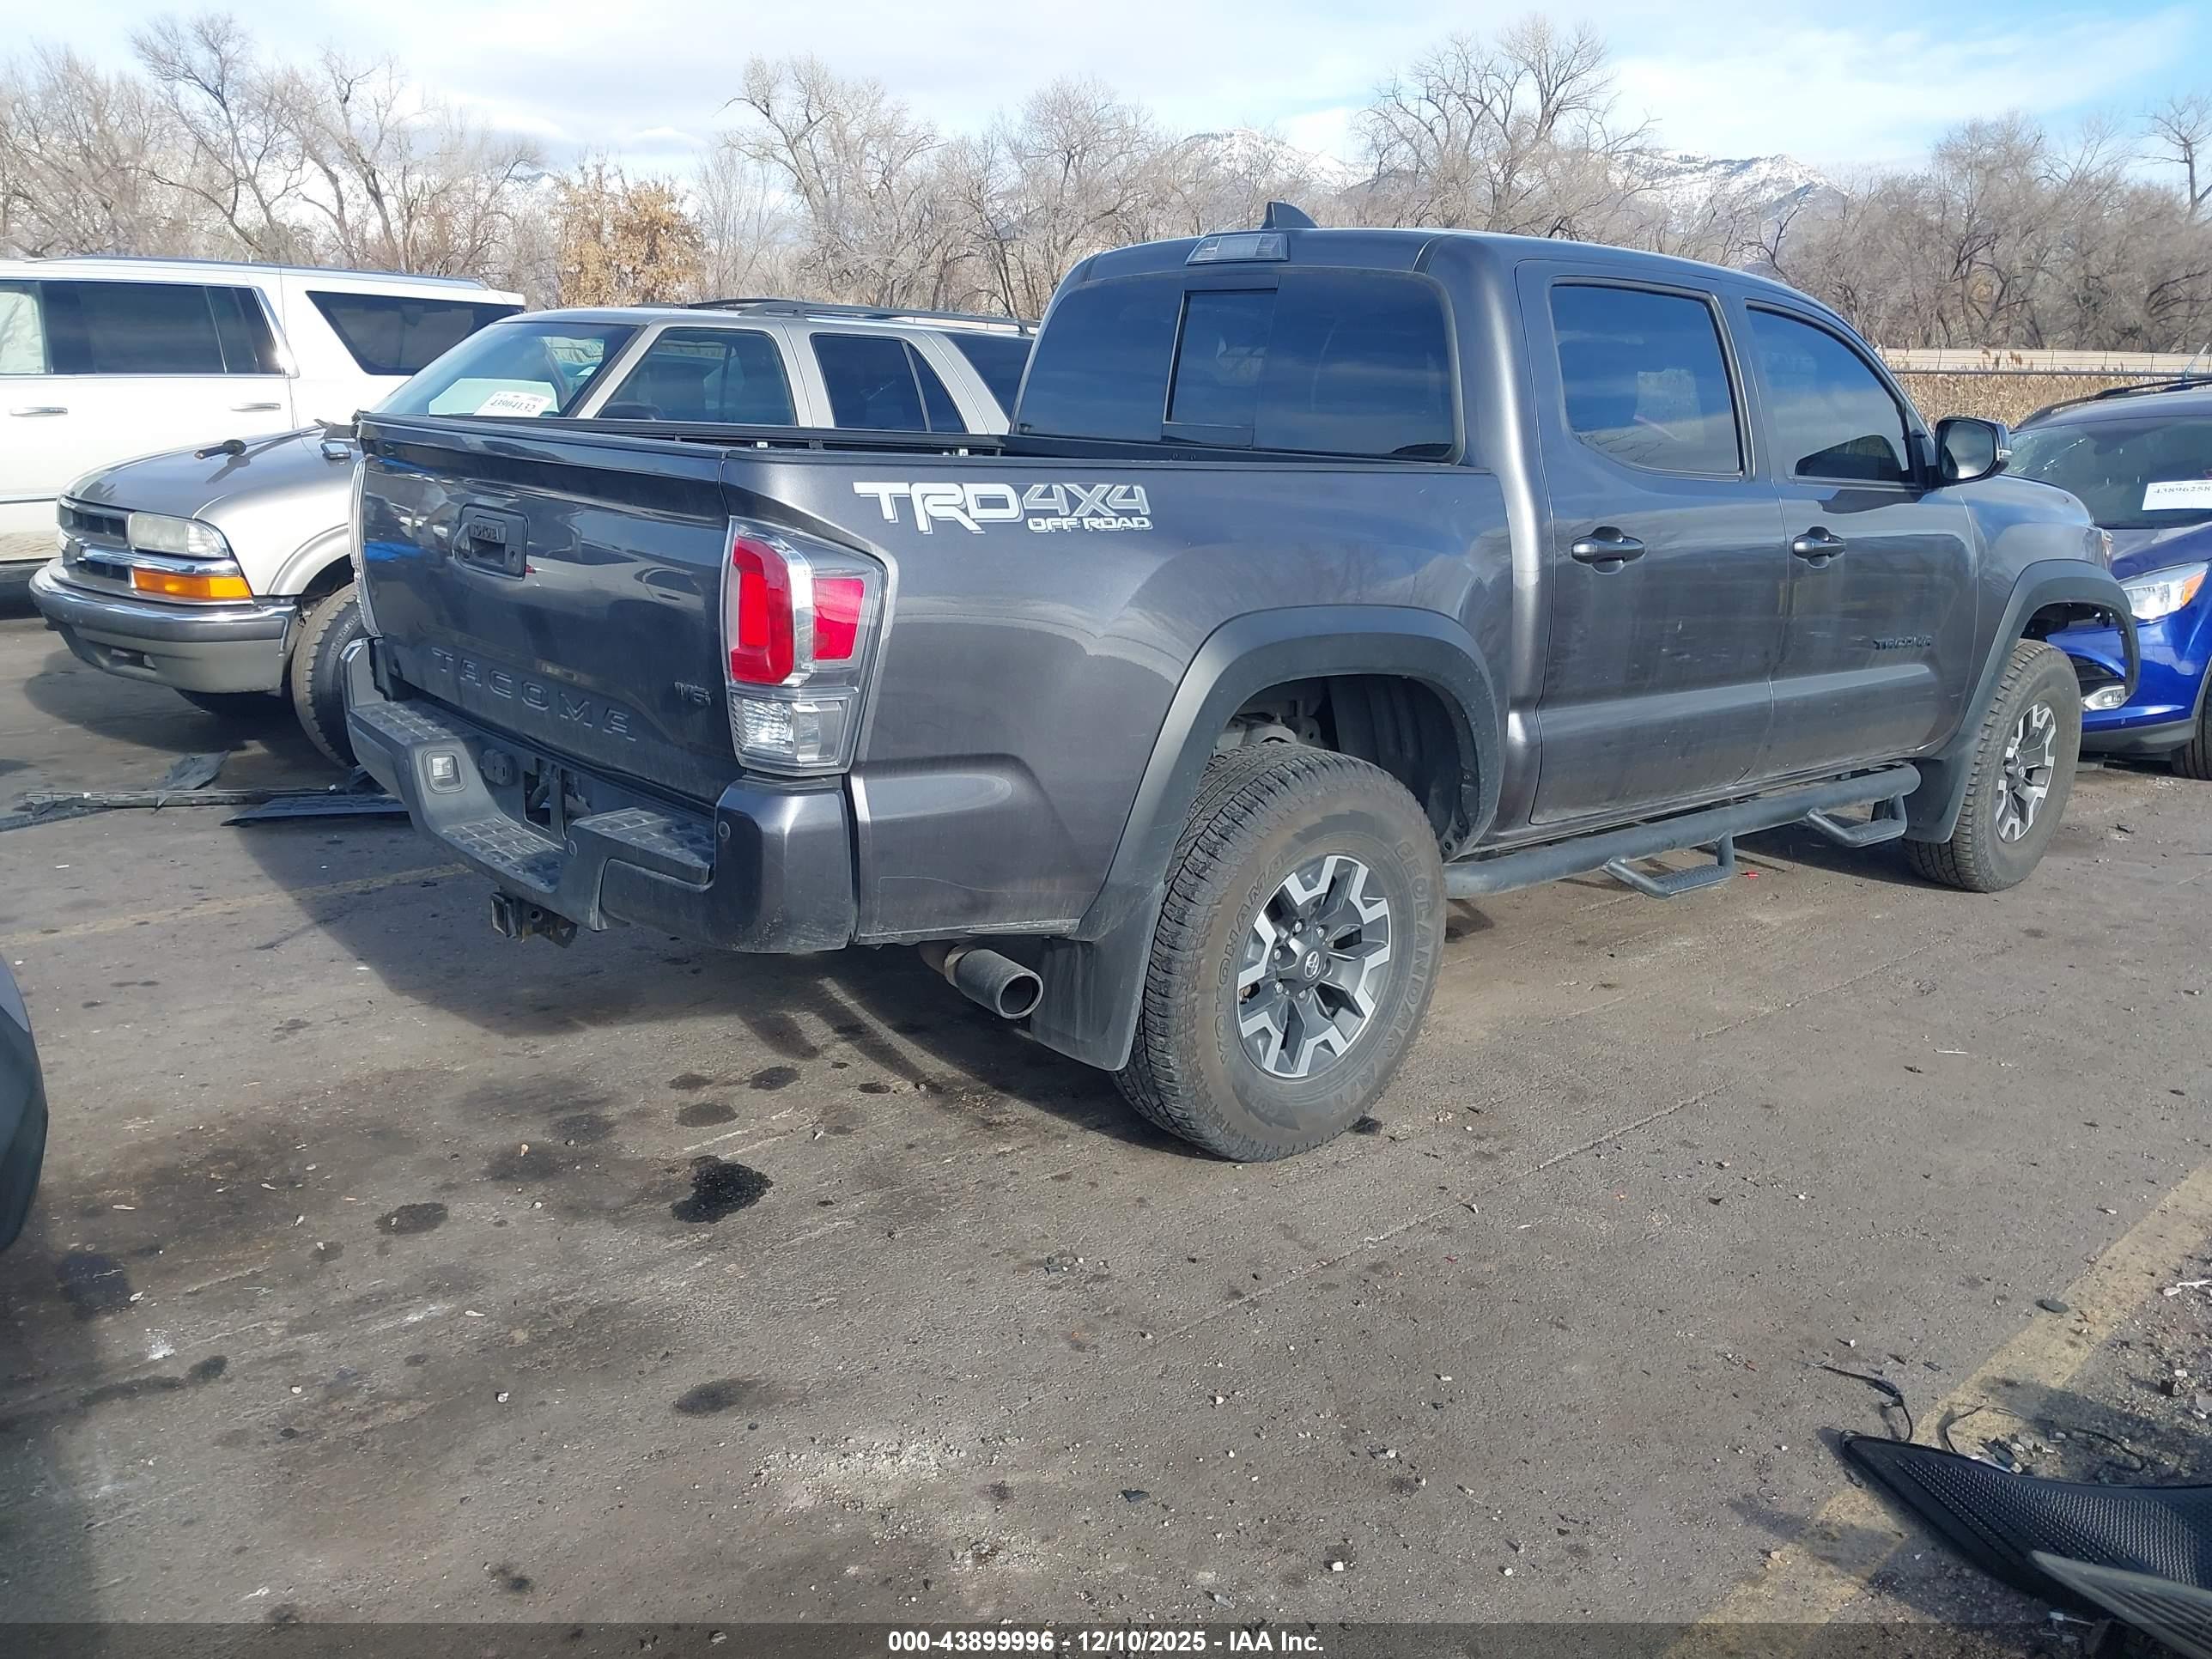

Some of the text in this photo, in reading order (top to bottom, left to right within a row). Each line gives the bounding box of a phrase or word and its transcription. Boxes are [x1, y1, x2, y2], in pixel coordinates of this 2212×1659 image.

[852, 482, 1024, 534] TRD
[1028, 517, 1154, 533] OFF ROAD
[431, 646, 637, 743] TACOMA
[673, 680, 712, 707] V6
[1213, 852, 1285, 1066] YOKOHAMA
[1381, 841, 1433, 1059] GEOLANDAR
